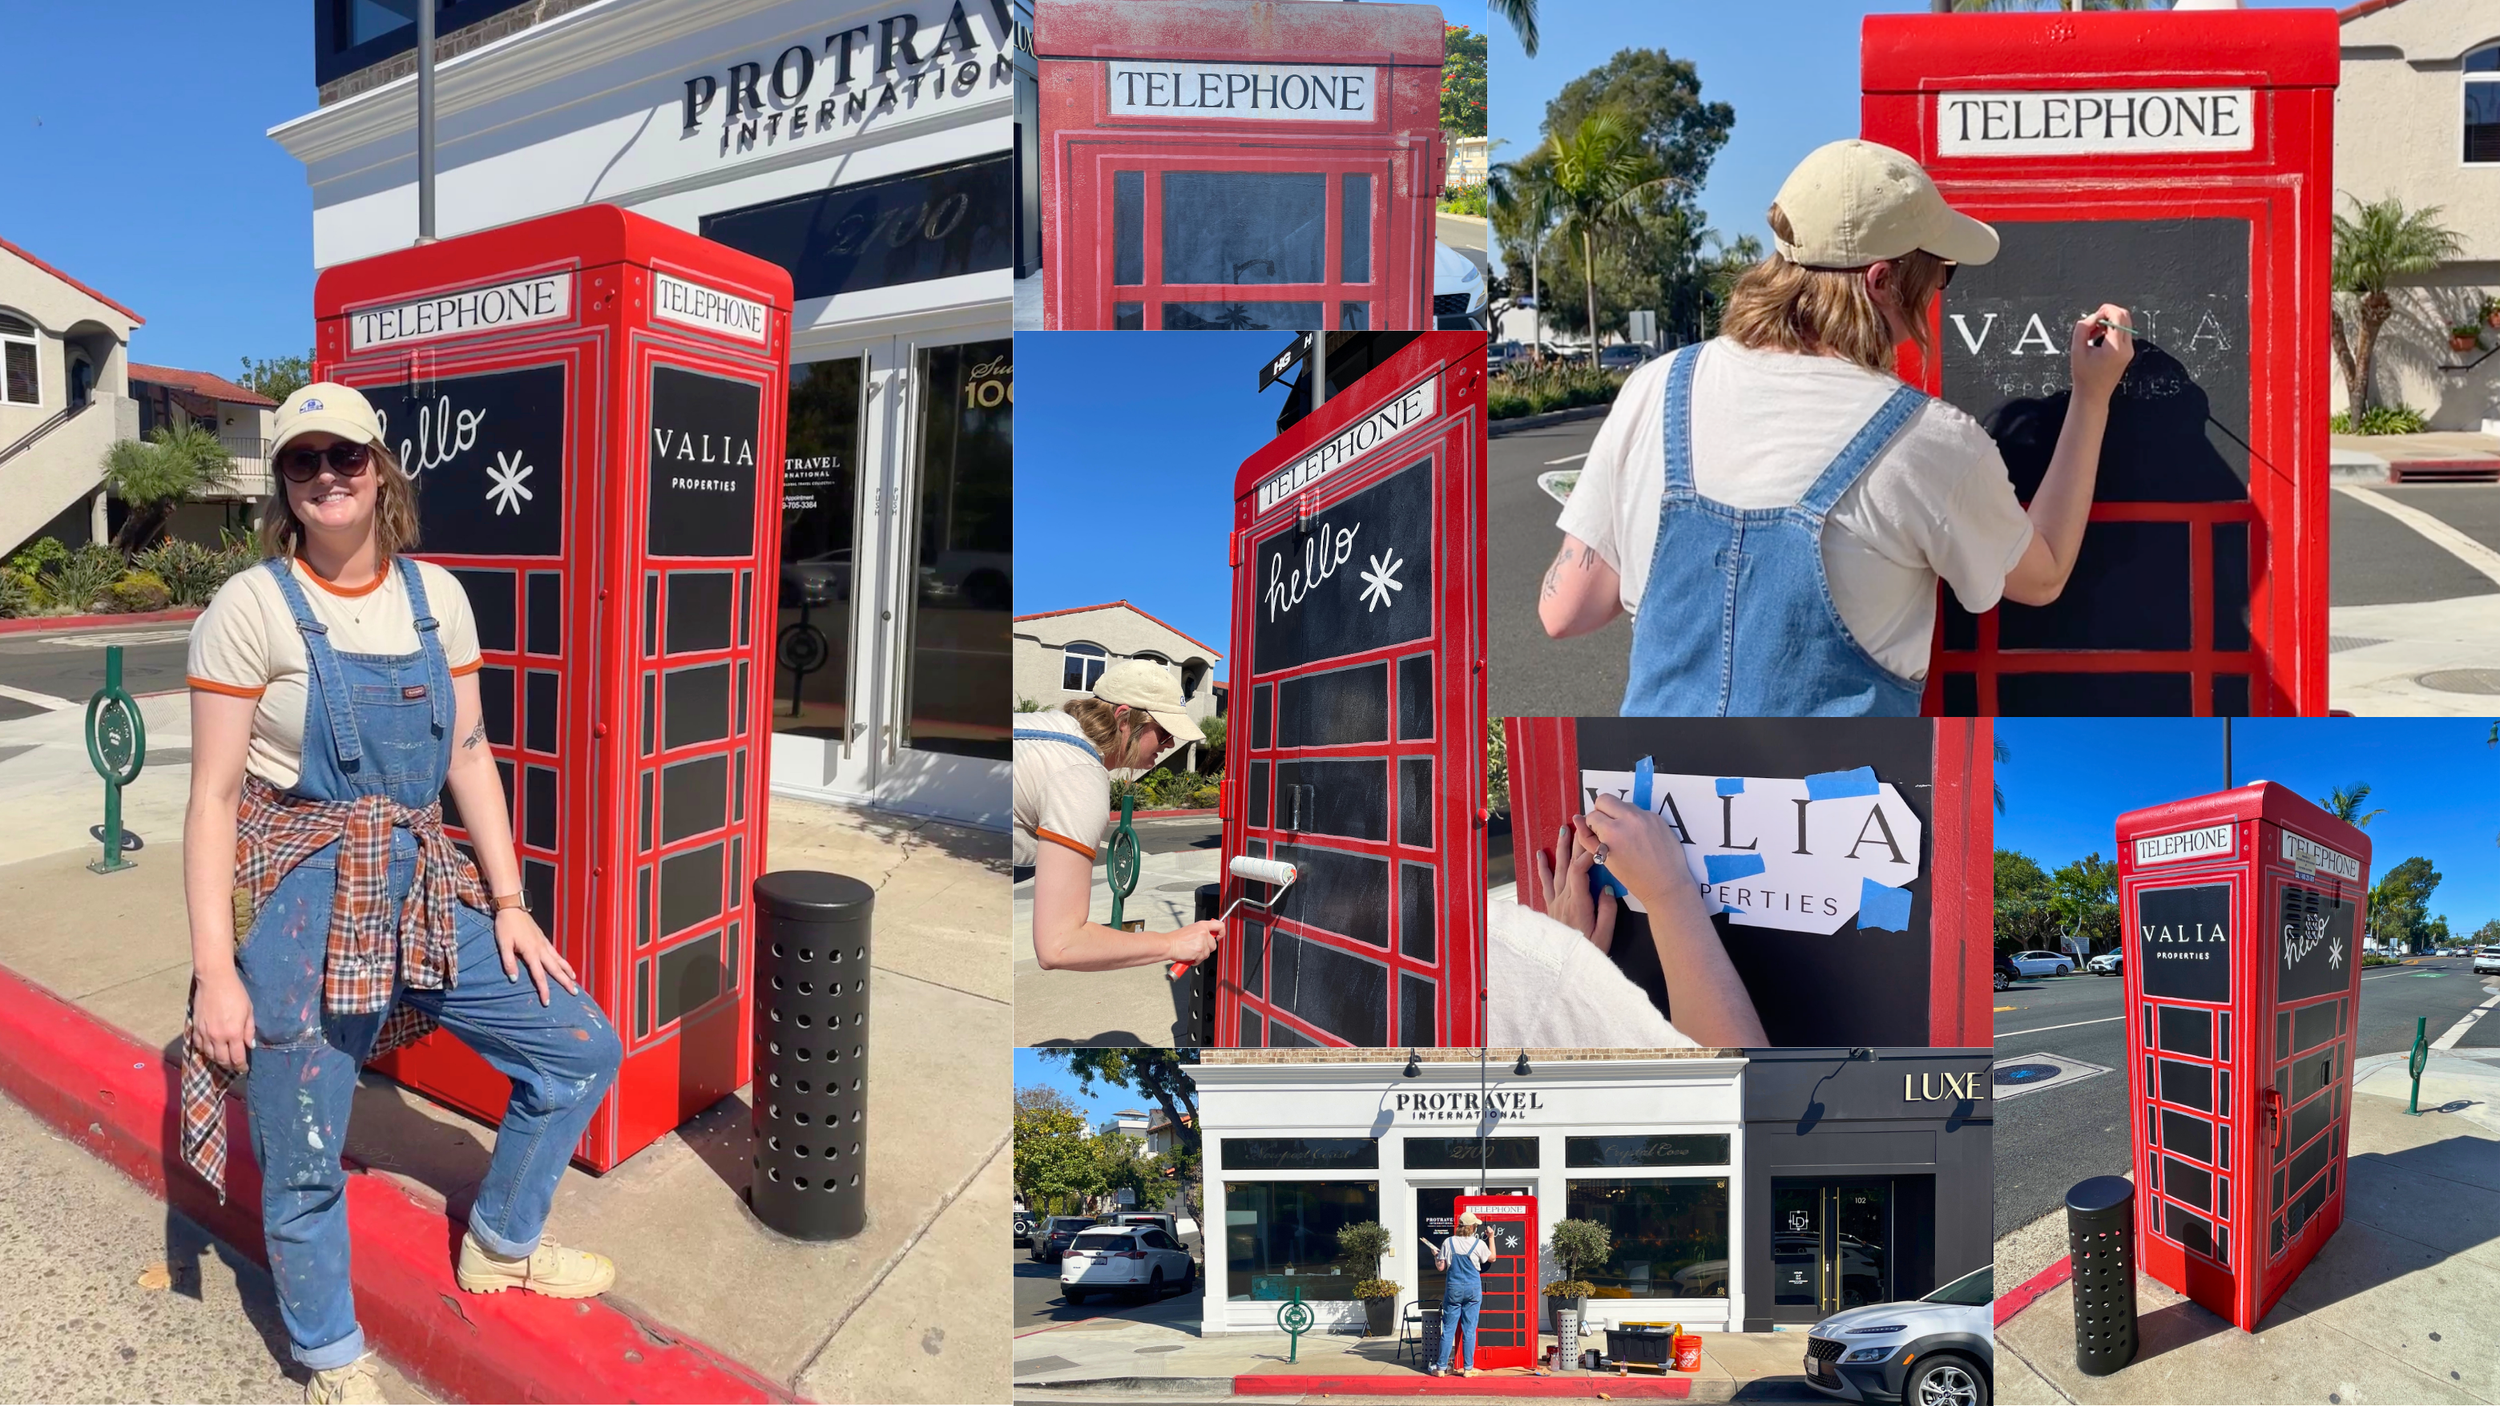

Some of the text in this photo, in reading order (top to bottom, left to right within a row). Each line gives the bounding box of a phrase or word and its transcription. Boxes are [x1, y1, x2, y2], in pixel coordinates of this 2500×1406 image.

[1117, 71, 1364, 111] TELEPHONE
[1949, 95, 2240, 140] TELEPHONE
[359, 280, 558, 344] TELEPHONE
[659, 279, 763, 334] TELEPHONE
[1303, 332, 1314, 349] H
[1949, 309, 2231, 355] VAIA
[1273, 351, 1291, 376] HG
[965, 379, 1013, 409] 10
[654, 428, 755, 466] VALIA
[1264, 390, 1423, 506] TELEPHONE
[672, 477, 736, 492] PROPERTIES
[1264, 522, 1360, 623] hello
[2139, 828, 2228, 859] TELEPHONE
[2142, 923, 2226, 943] VALIA
[2284, 914, 2330, 970] hello
[2157, 952, 2210, 960] PROPERTIES
[1905, 1072, 1984, 1101] LUXE
[1396, 1092, 1544, 1111] PROTRAVEL
[1413, 1111, 1525, 1120] INTERNATIONAL
[1245, 1146, 1351, 1167] Newport Coast
[1451, 1145, 1495, 1160] 2700
[1604, 1143, 1659, 1165] Crystal
